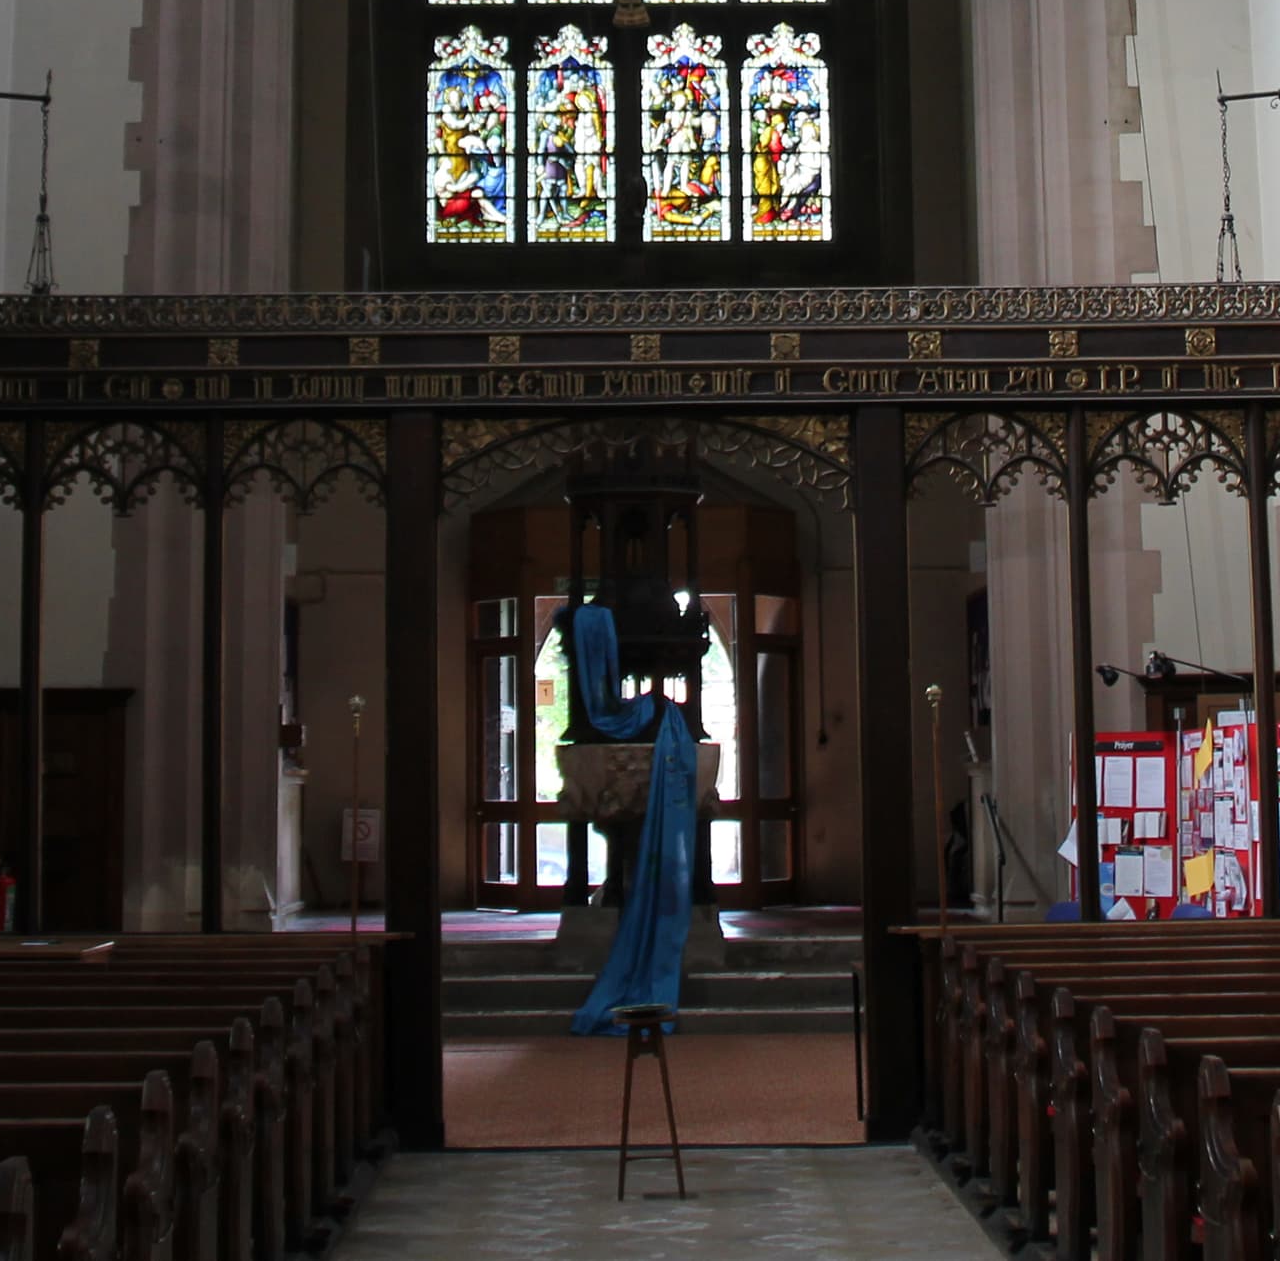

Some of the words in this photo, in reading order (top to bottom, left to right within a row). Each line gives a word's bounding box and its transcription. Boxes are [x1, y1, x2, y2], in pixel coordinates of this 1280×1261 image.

[66, 374, 85, 402] of
[103, 374, 150, 402] God
[195, 373, 231, 400] and
[251, 375, 273, 400] in
[385, 373, 463, 400] memory
[478, 371, 496, 397] of
[517, 370, 585, 400] Emily
[601, 369, 683, 399] Martha
[712, 368, 752, 395] wife
[775, 368, 792, 394] of
[822, 366, 900, 396] George
[916, 366, 992, 395] Anson
[1160, 363, 1179, 392] of
[1204, 363, 1240, 391] this
